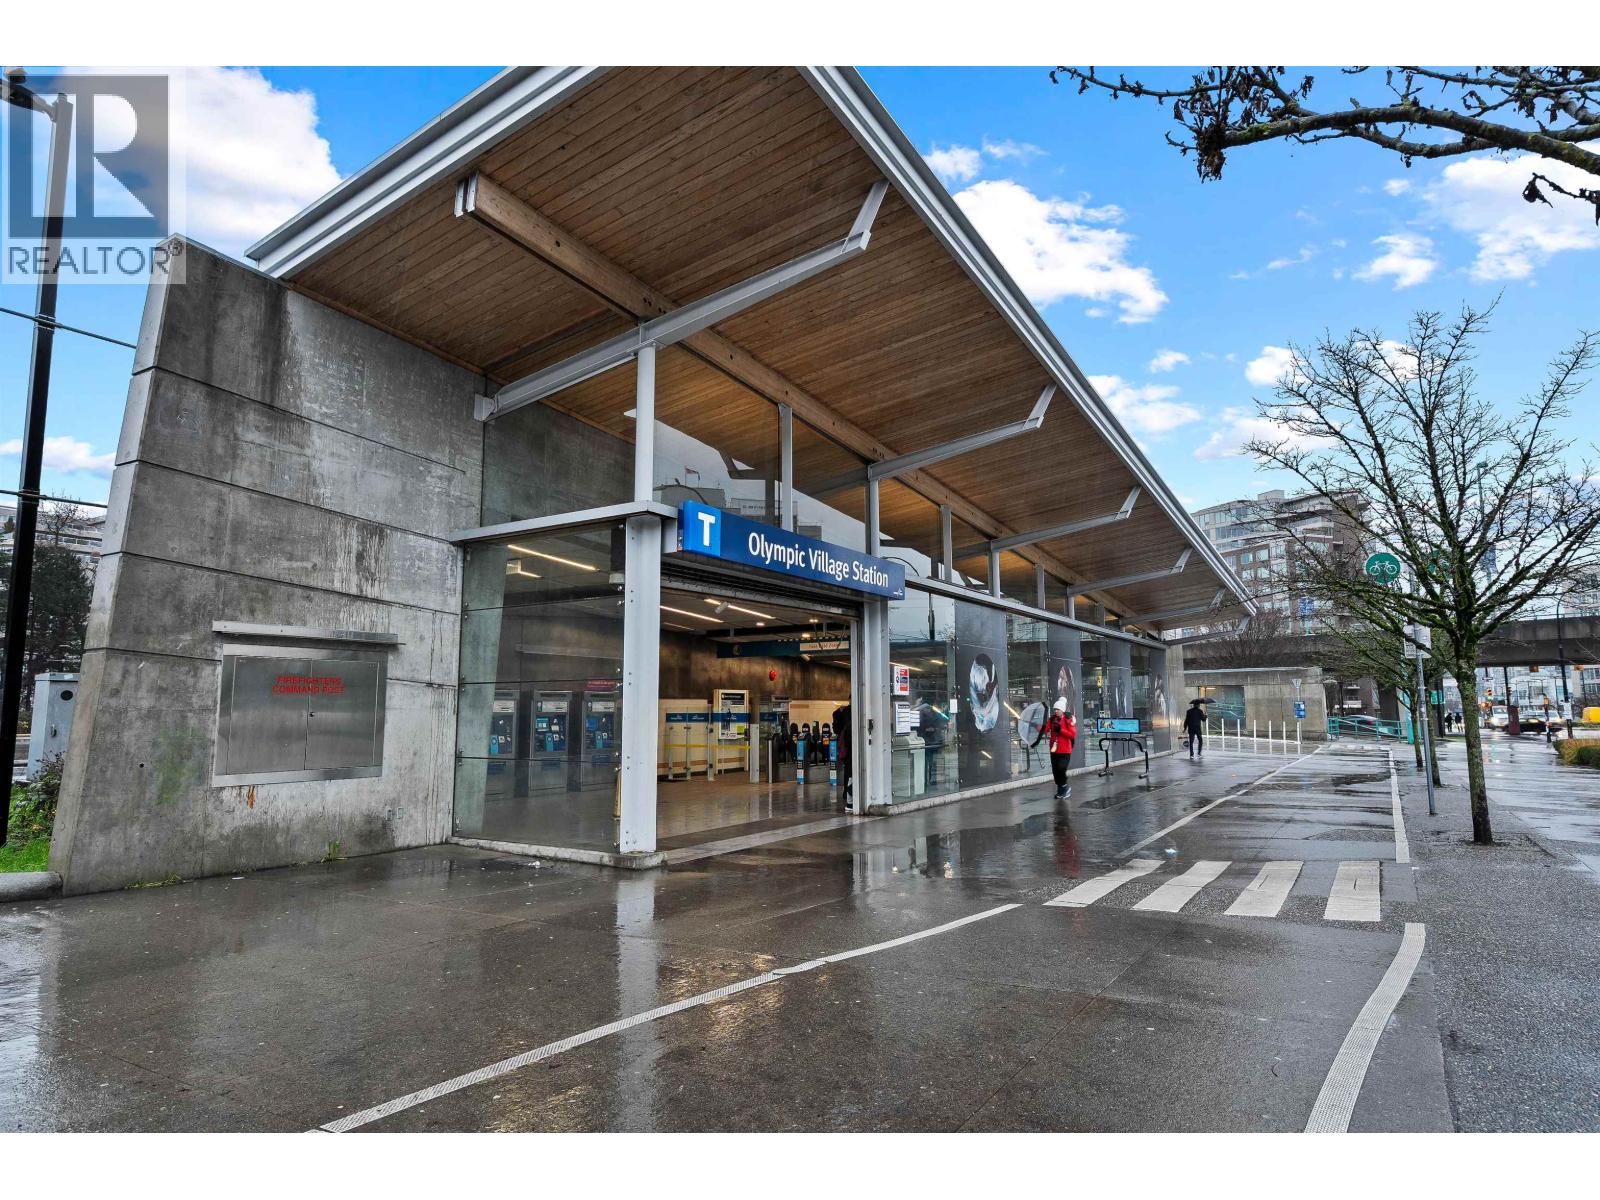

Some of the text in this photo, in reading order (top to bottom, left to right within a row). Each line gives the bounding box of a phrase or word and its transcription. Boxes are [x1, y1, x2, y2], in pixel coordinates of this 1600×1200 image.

[697, 511, 716, 547] T
[748, 532, 889, 588] Olympic Village Station
